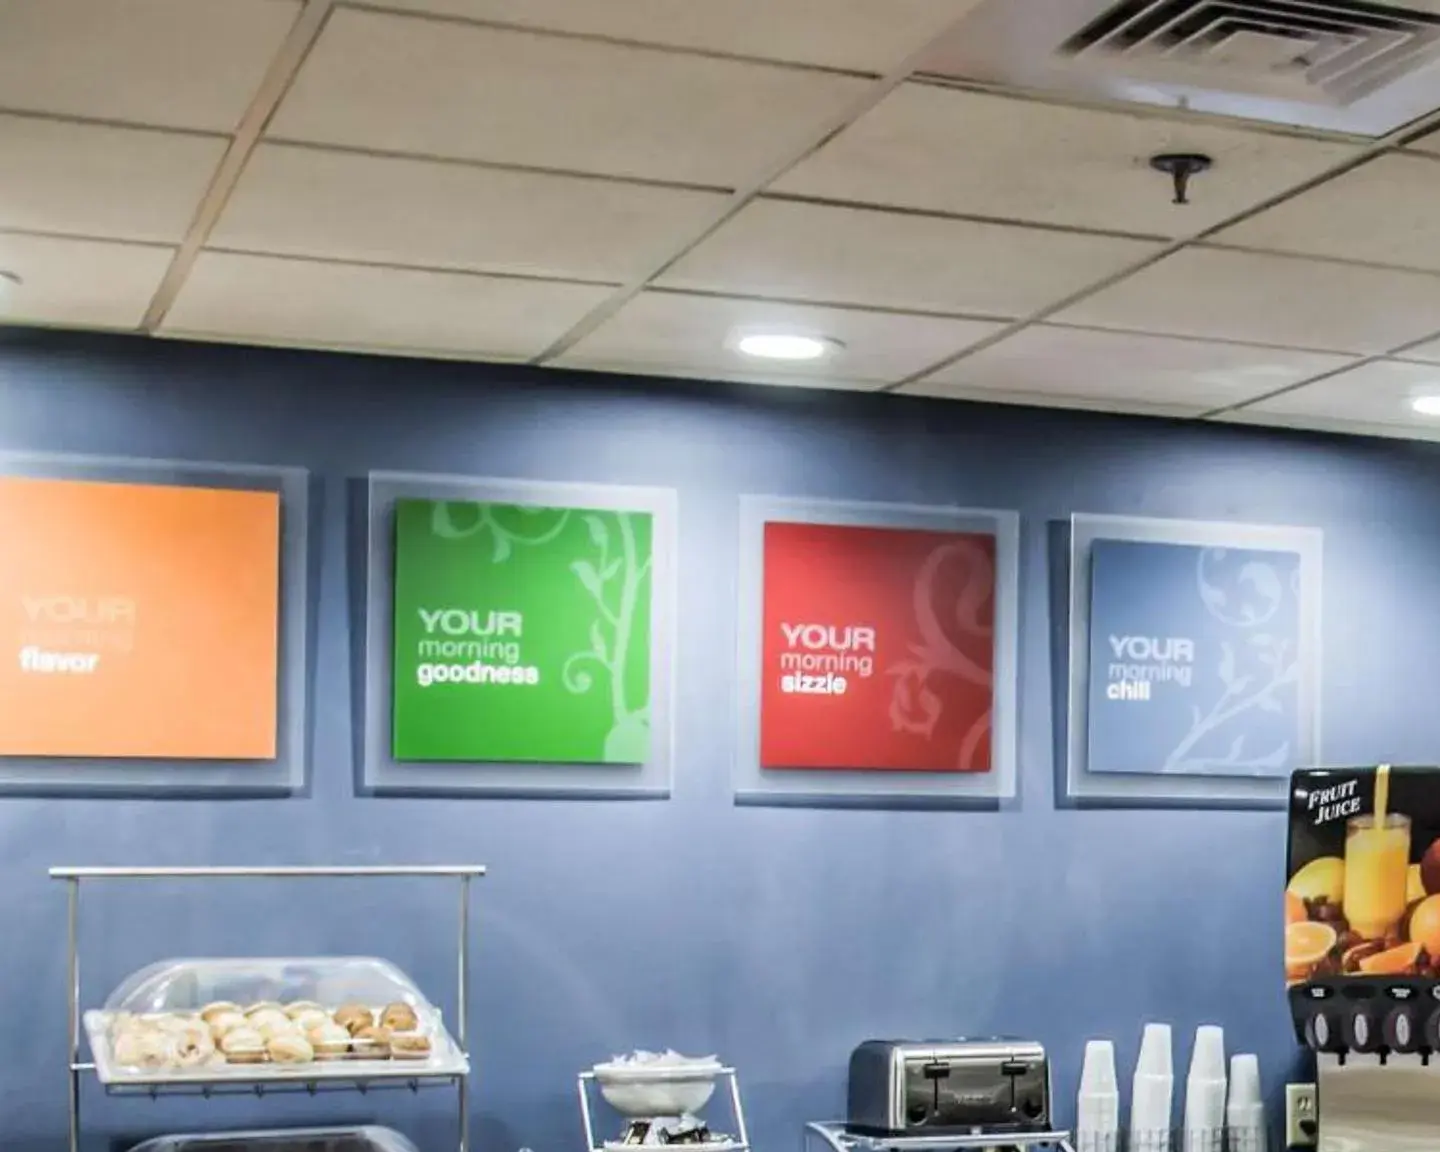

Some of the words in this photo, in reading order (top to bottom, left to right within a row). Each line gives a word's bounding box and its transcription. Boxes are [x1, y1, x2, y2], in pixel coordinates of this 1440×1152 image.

[21, 597, 136, 624] YOUR
[418, 607, 522, 637] YOUR
[780, 622, 876, 651] YOUR
[1108, 634, 1195, 662] YOUR
[19, 645, 100, 673] flavor
[418, 637, 519, 664] morning
[418, 660, 539, 686] goodness
[781, 652, 873, 677] morning
[1108, 661, 1192, 687] morning
[780, 671, 848, 695] sizzle
[1107, 680, 1151, 700] chill
[1308, 779, 1358, 810] FRUIT
[1314, 796, 1360, 825] JUICE
